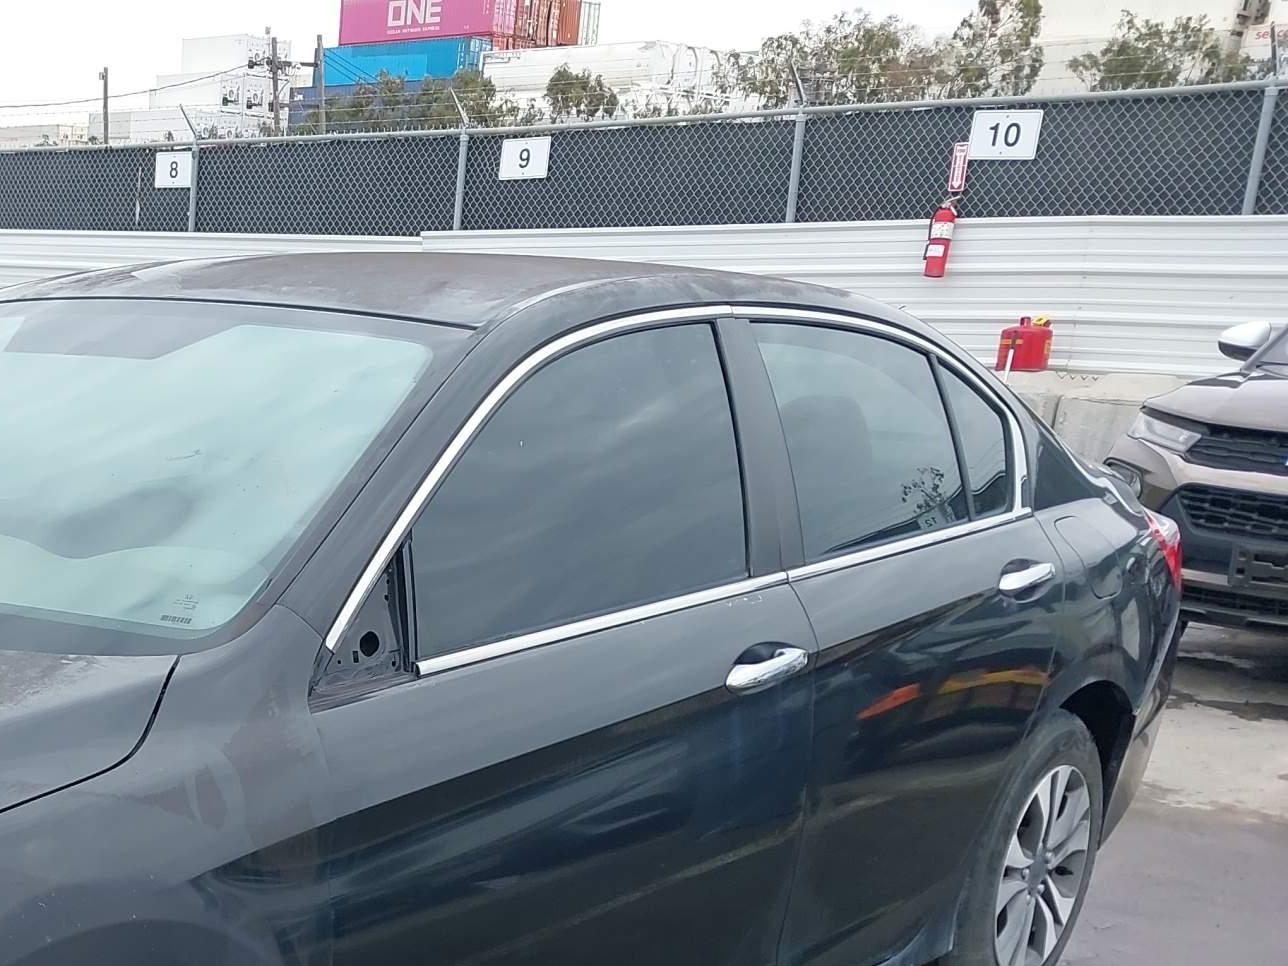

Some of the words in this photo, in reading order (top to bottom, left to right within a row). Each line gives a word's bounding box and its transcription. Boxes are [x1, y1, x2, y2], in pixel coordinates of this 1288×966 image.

[387, 0, 442, 27] ONE
[989, 122, 1021, 147] 10
[169, 160, 178, 179] 8
[518, 148, 531, 169] 9
